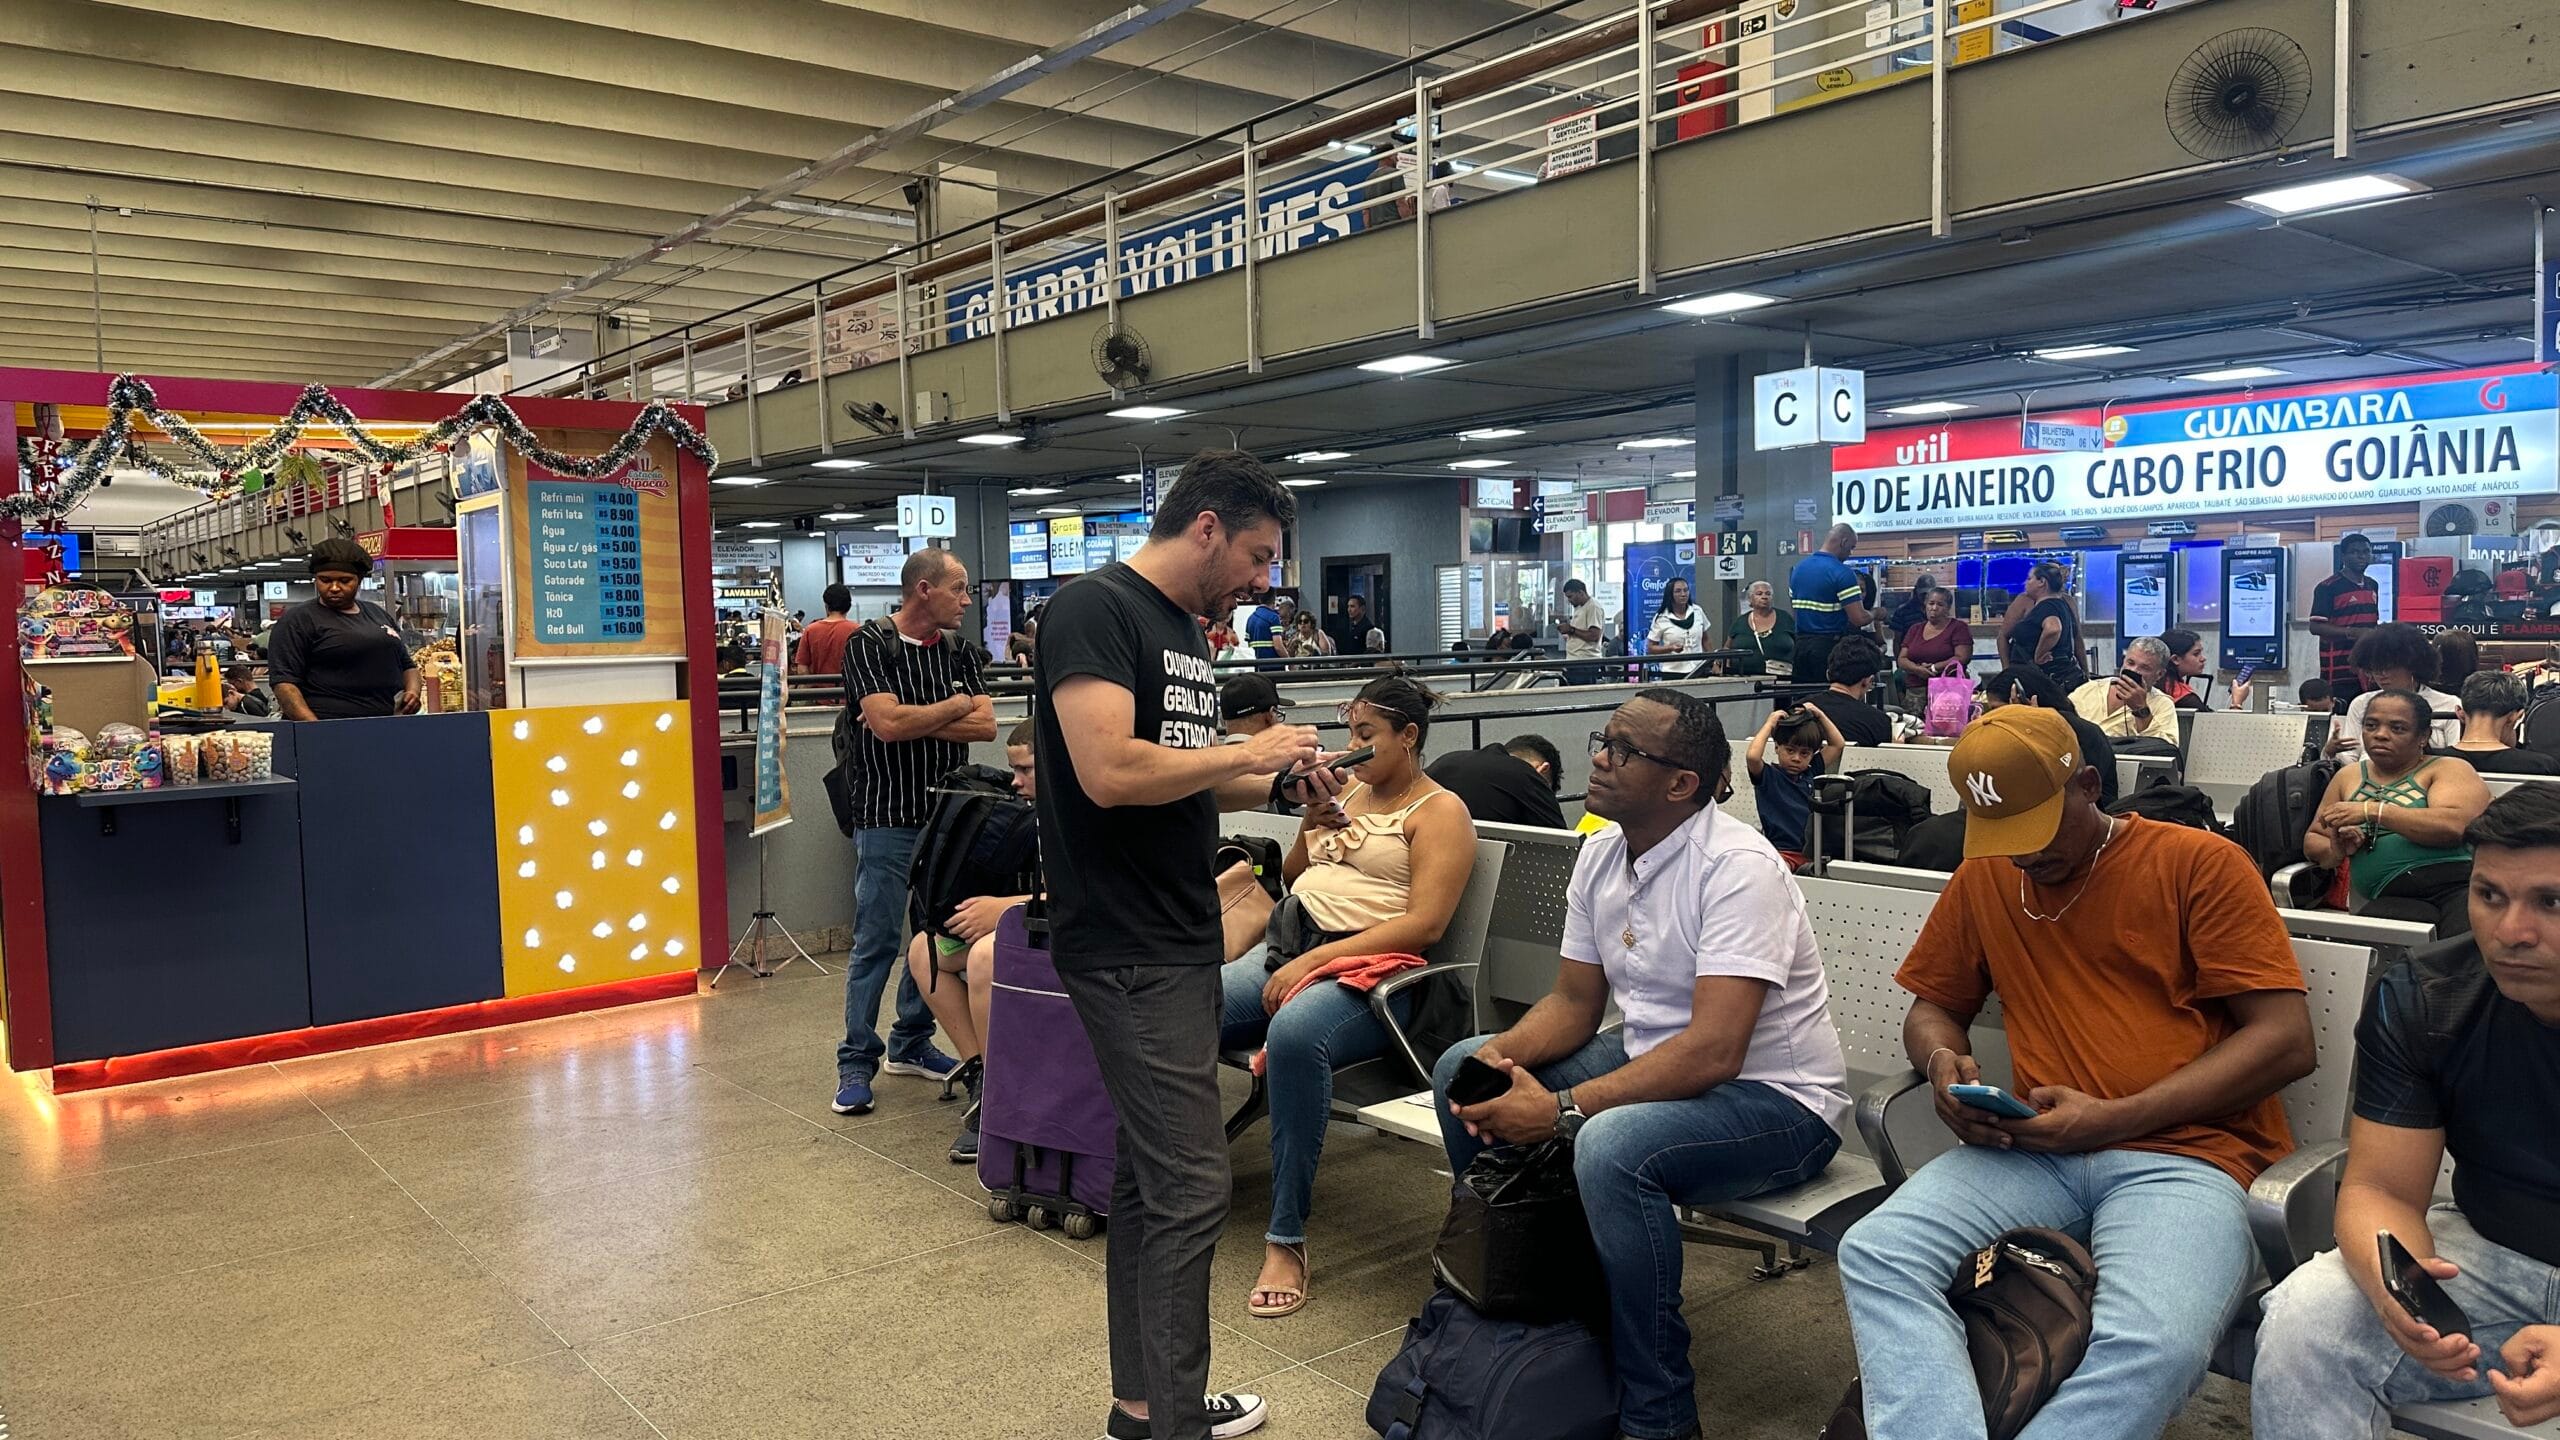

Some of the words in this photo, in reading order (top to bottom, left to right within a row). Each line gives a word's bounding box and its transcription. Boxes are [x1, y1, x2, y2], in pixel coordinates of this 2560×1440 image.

[966, 258, 1111, 339] GUARDA
[1126, 182, 1351, 294] VOLUMES
[1774, 392, 1798, 426] C
[1834, 388, 1851, 423] C
[2184, 391, 2414, 439] GUANABARA
[2479, 378, 2506, 411] G
[2041, 426, 2075, 437] BILHETERIA
[1896, 431, 1949, 465] util
[2041, 437, 2066, 447] TICKETS
[2079, 438, 2087, 448] 06
[2325, 423, 2521, 483] GOIÂNIA
[627, 469, 664, 479] Estação
[2087, 454, 2184, 499] CABO
[2196, 445, 2287, 492] FRIO
[619, 477, 670, 489] Pipocas
[2426, 485, 2450, 495] SANTO
[2452, 482, 2477, 493] ANDRÉ
[2481, 480, 2520, 491] ANÁPOLIS
[1874, 476, 1911, 514] DE
[1917, 464, 2055, 511] JANEIRO
[2378, 487, 2422, 497] GUARULHOS
[541, 492, 563, 502] Refri
[565, 493, 585, 503] mini
[1478, 497, 1513, 505] CATEDRAL
[2235, 497, 2248, 506] SÃO
[2249, 495, 2283, 505] SEBASTIÃO
[2287, 493, 2300, 503] SÃO
[2301, 492, 2337, 502] BERNARDO
[2338, 491, 2348, 500] DO
[2350, 489, 2374, 499] CAMPO
[2167, 501, 2200, 510] APARECIDA
[2204, 498, 2231, 508] TAUBATÉ
[542, 509, 563, 519] Refri
[566, 509, 583, 519] lata
[1647, 506, 1680, 516] ELEVADOR
[2101, 506, 2112, 514] SÃO
[2113, 505, 2126, 513] JOSÉ
[905, 507, 913, 525] D
[932, 507, 945, 525] D
[1546, 515, 1576, 524] ELEVADOR
[2485, 518, 2499, 526] LG
[542, 525, 565, 537] Água
[543, 539, 566, 554] Água
[568, 543, 579, 552] c/
[582, 542, 598, 554] gás
[1051, 538, 1084, 558] BELÉM
[544, 558, 566, 569] Suco
[568, 559, 587, 569] Lata
[544, 575, 585, 585] Gatorade
[53, 591, 97, 601] DIVER
[273, 586, 282, 595] G
[724, 589, 767, 597] BAVARIAN
[545, 591, 574, 602] Tônica
[547, 624, 564, 634] Red
[567, 624, 584, 634] Bull
[2416, 624, 2446, 635] SSO
[2490, 622, 2499, 635] É
[2503, 624, 2560, 634] FLAMEN
[1163, 684, 1199, 716] GERAL
[1199, 690, 1215, 718] DO
[1159, 720, 1207, 749] ESTADO
[84, 761, 131, 775] DIVER
[1966, 771, 2002, 806] NY
